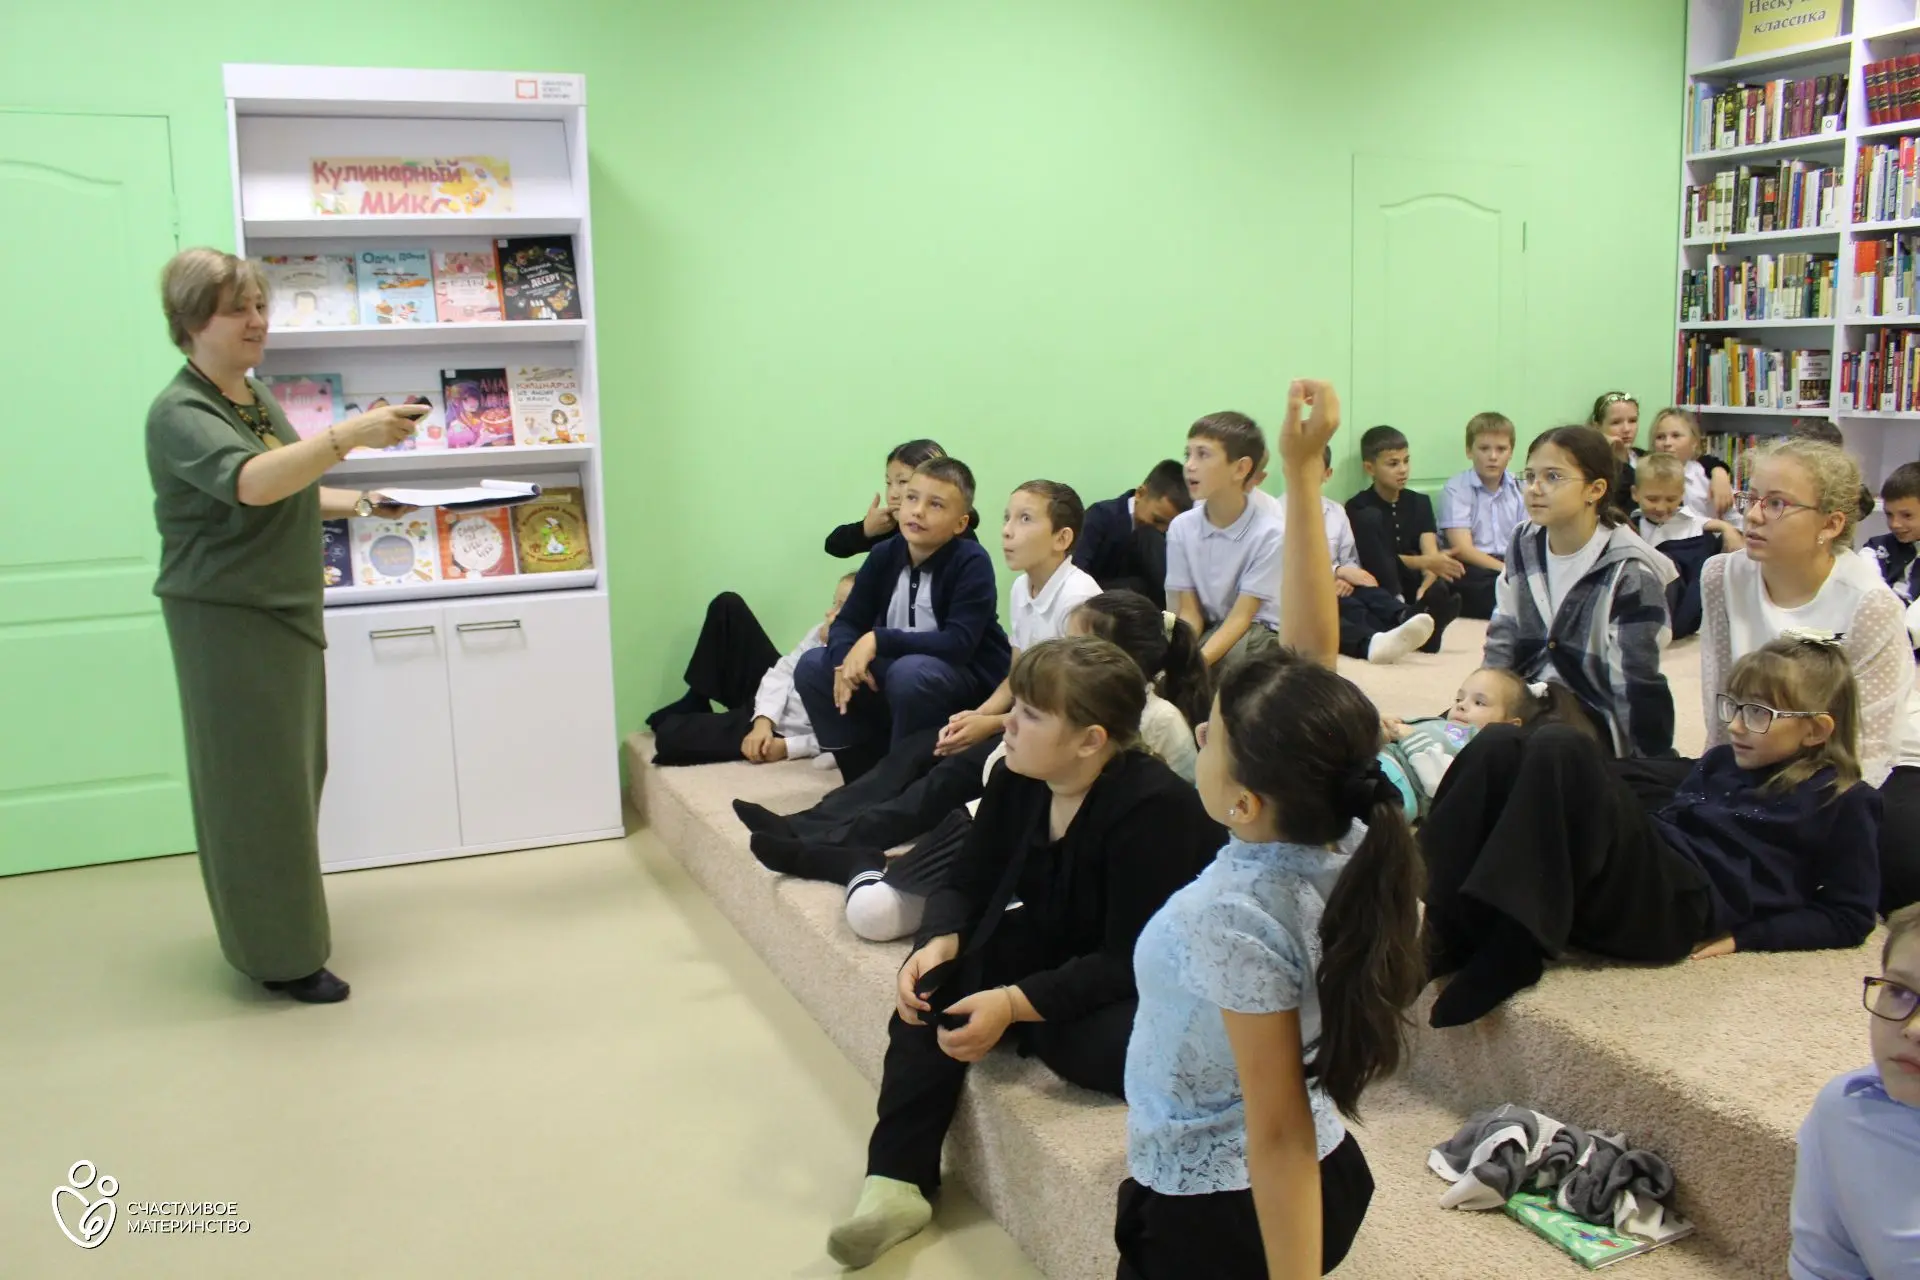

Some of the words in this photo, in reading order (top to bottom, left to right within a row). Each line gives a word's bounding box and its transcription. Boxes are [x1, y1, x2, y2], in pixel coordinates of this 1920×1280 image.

[1749, 0, 1813, 14] Неску
[1753, 10, 1826, 34] классика
[313, 160, 463, 190] Кулинарный
